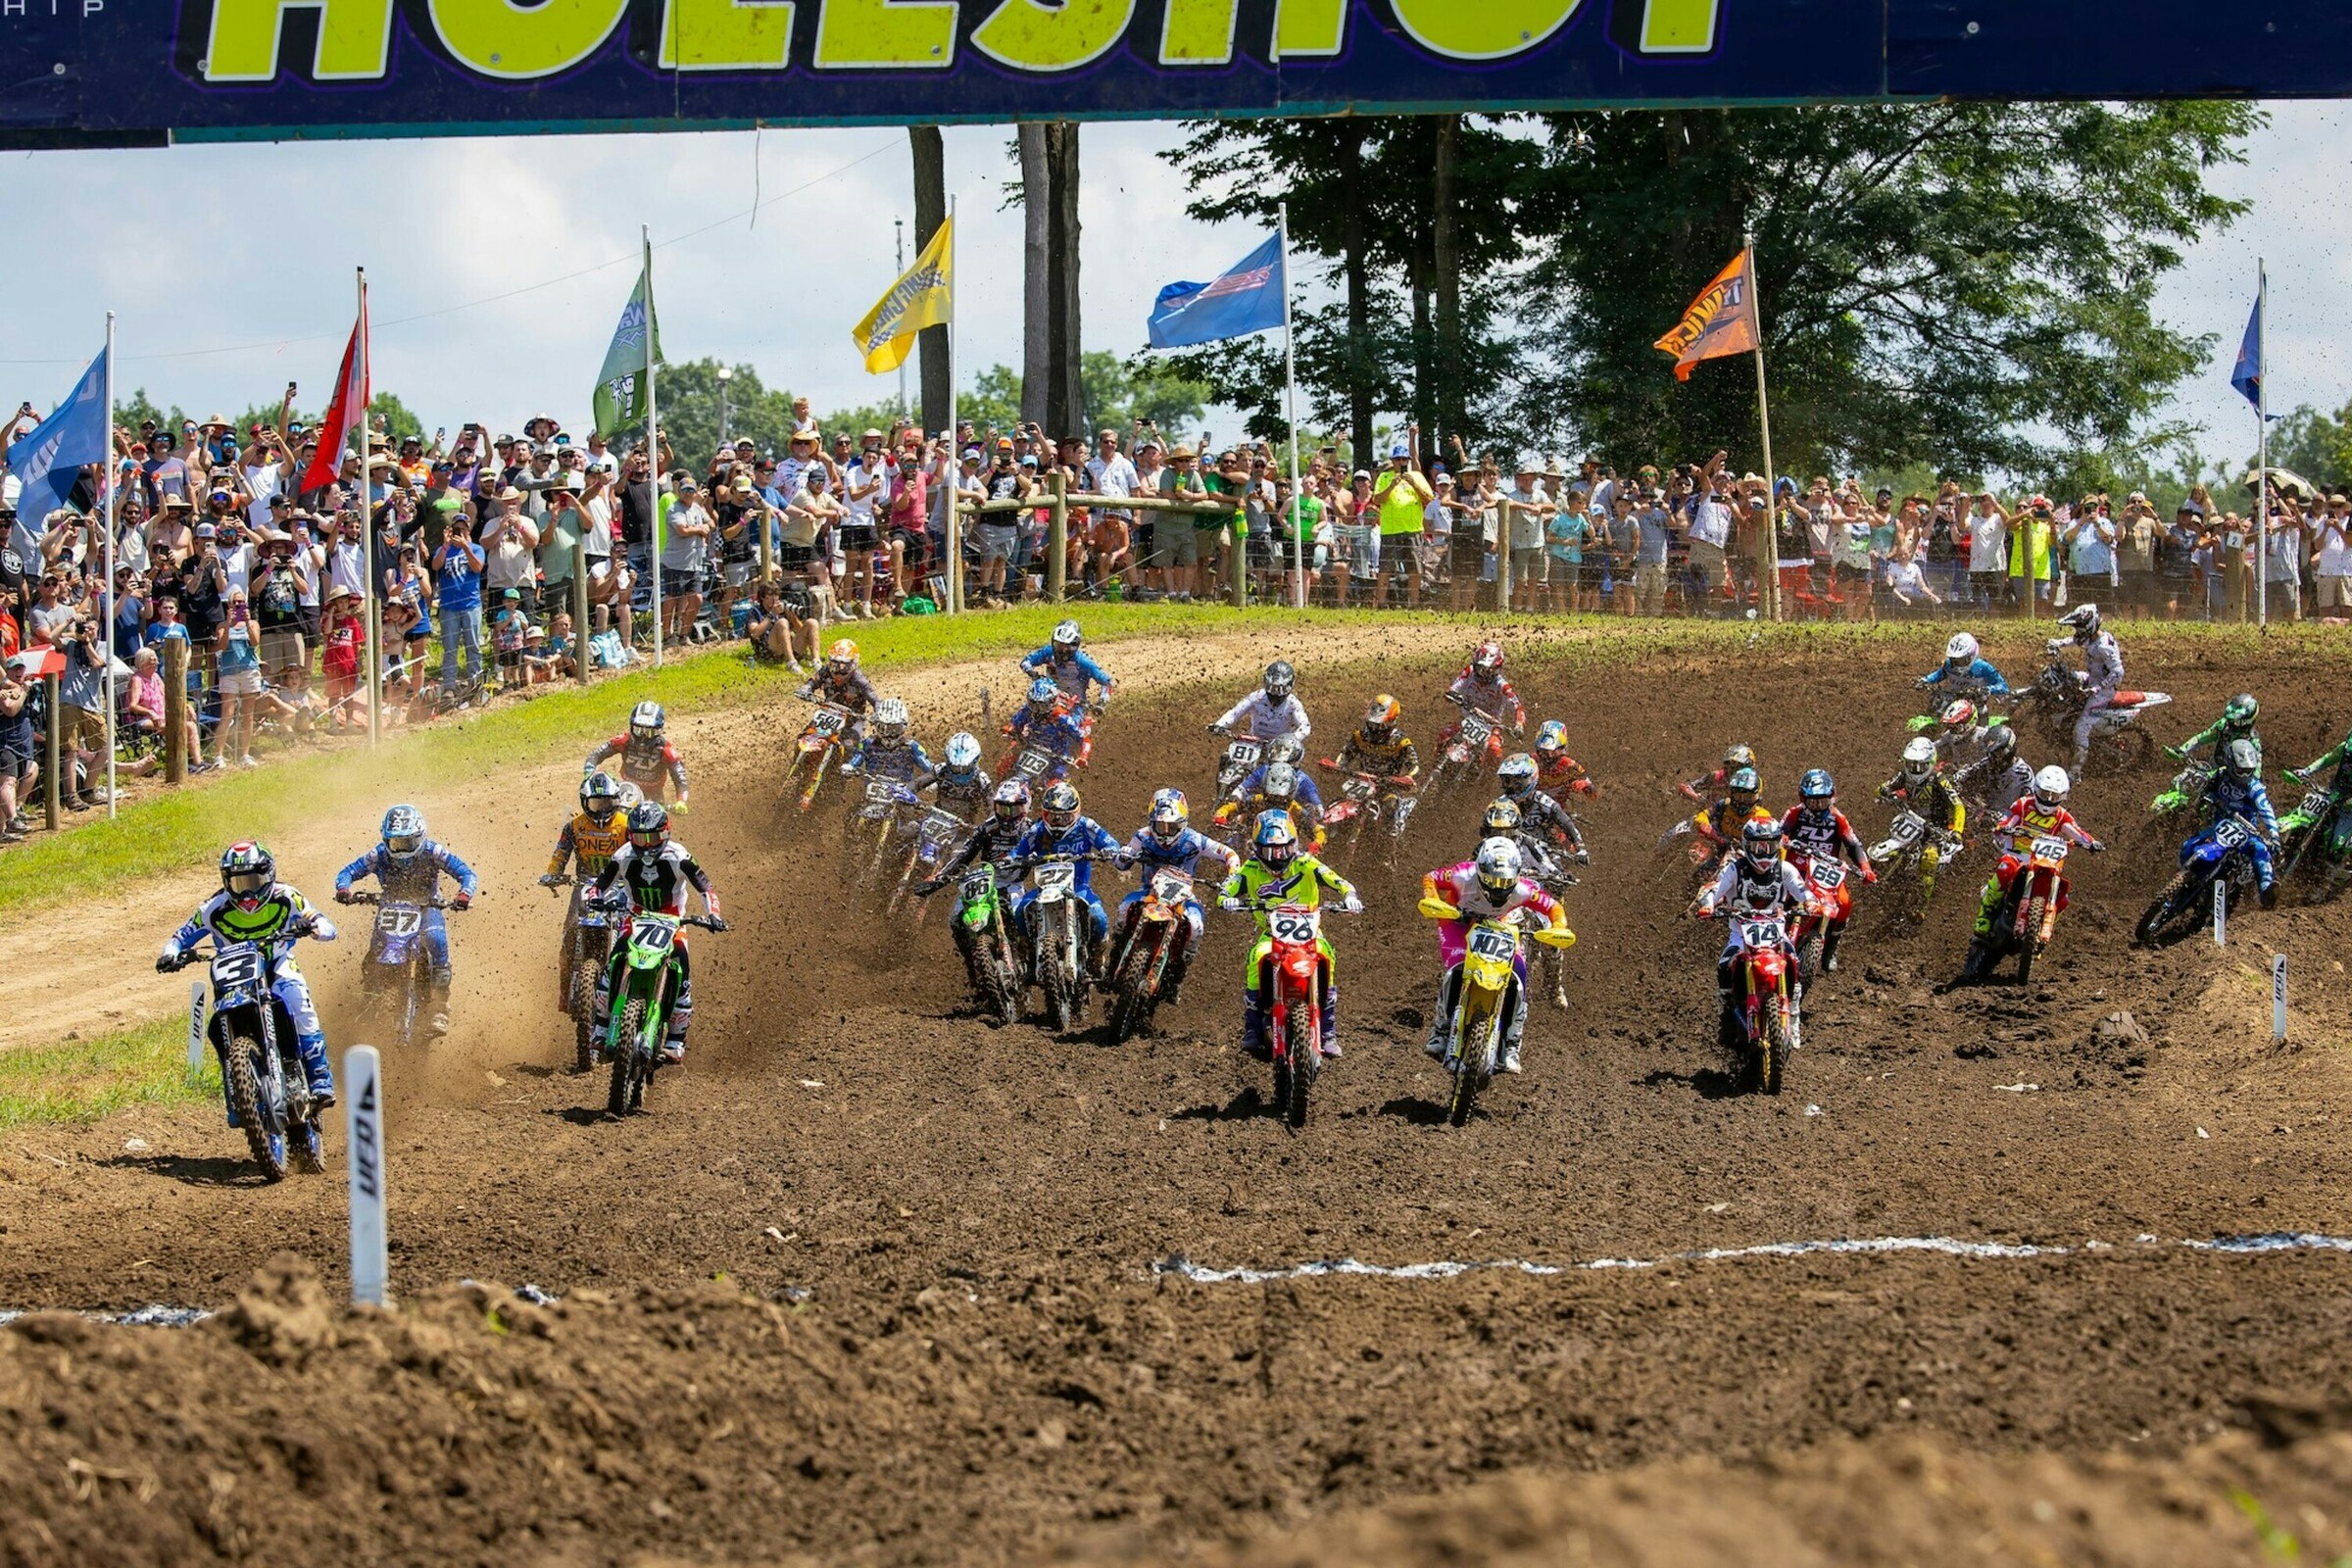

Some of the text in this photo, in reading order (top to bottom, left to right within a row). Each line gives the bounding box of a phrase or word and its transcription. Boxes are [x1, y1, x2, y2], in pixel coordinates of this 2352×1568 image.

[1234, 746, 1254, 760] 81
[1797, 825, 1836, 842] FLY
[2035, 843, 2065, 860] 146
[1038, 868, 1073, 885] 27
[1812, 863, 1841, 887] 69
[379, 907, 419, 933] 37
[1276, 919, 1314, 942] 96
[634, 923, 674, 950] 70
[1746, 923, 1780, 946] 14
[1471, 933, 1514, 961] 102
[216, 954, 258, 991] 3
[192, 1006, 203, 1041] UFO
[355, 1114, 378, 1200] UFO
